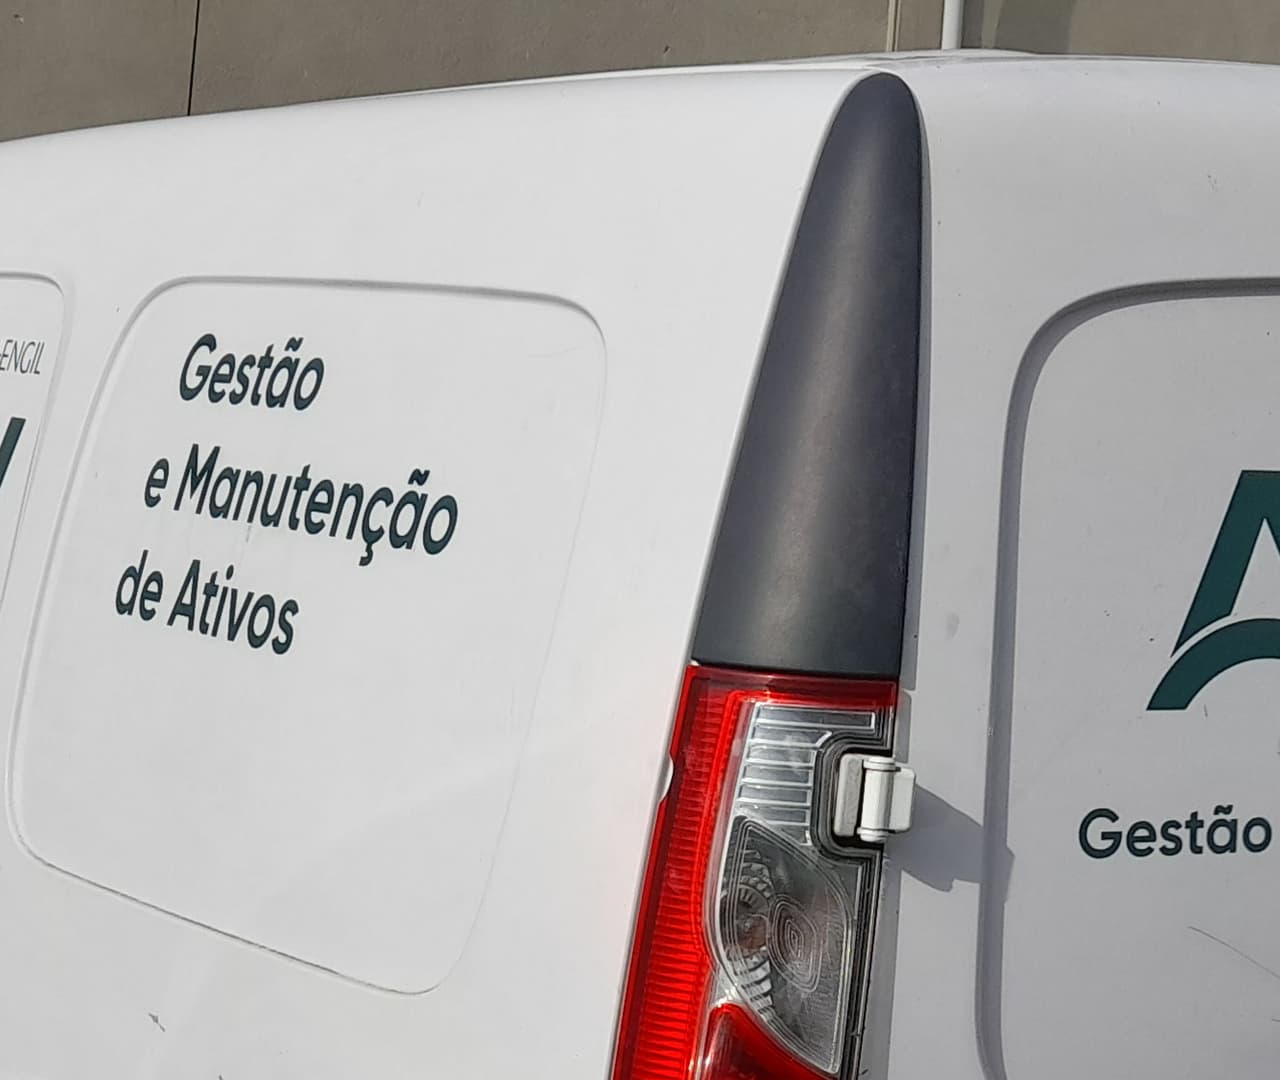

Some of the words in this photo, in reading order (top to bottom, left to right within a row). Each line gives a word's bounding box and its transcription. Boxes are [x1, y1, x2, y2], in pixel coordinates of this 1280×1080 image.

[178, 333, 325, 411] Gestão
[143, 454, 170, 508] e
[173, 443, 458, 566] Manutenção
[115, 550, 164, 623] de
[168, 560, 300, 655] Ativos
[1077, 805, 1273, 860] Gestão
